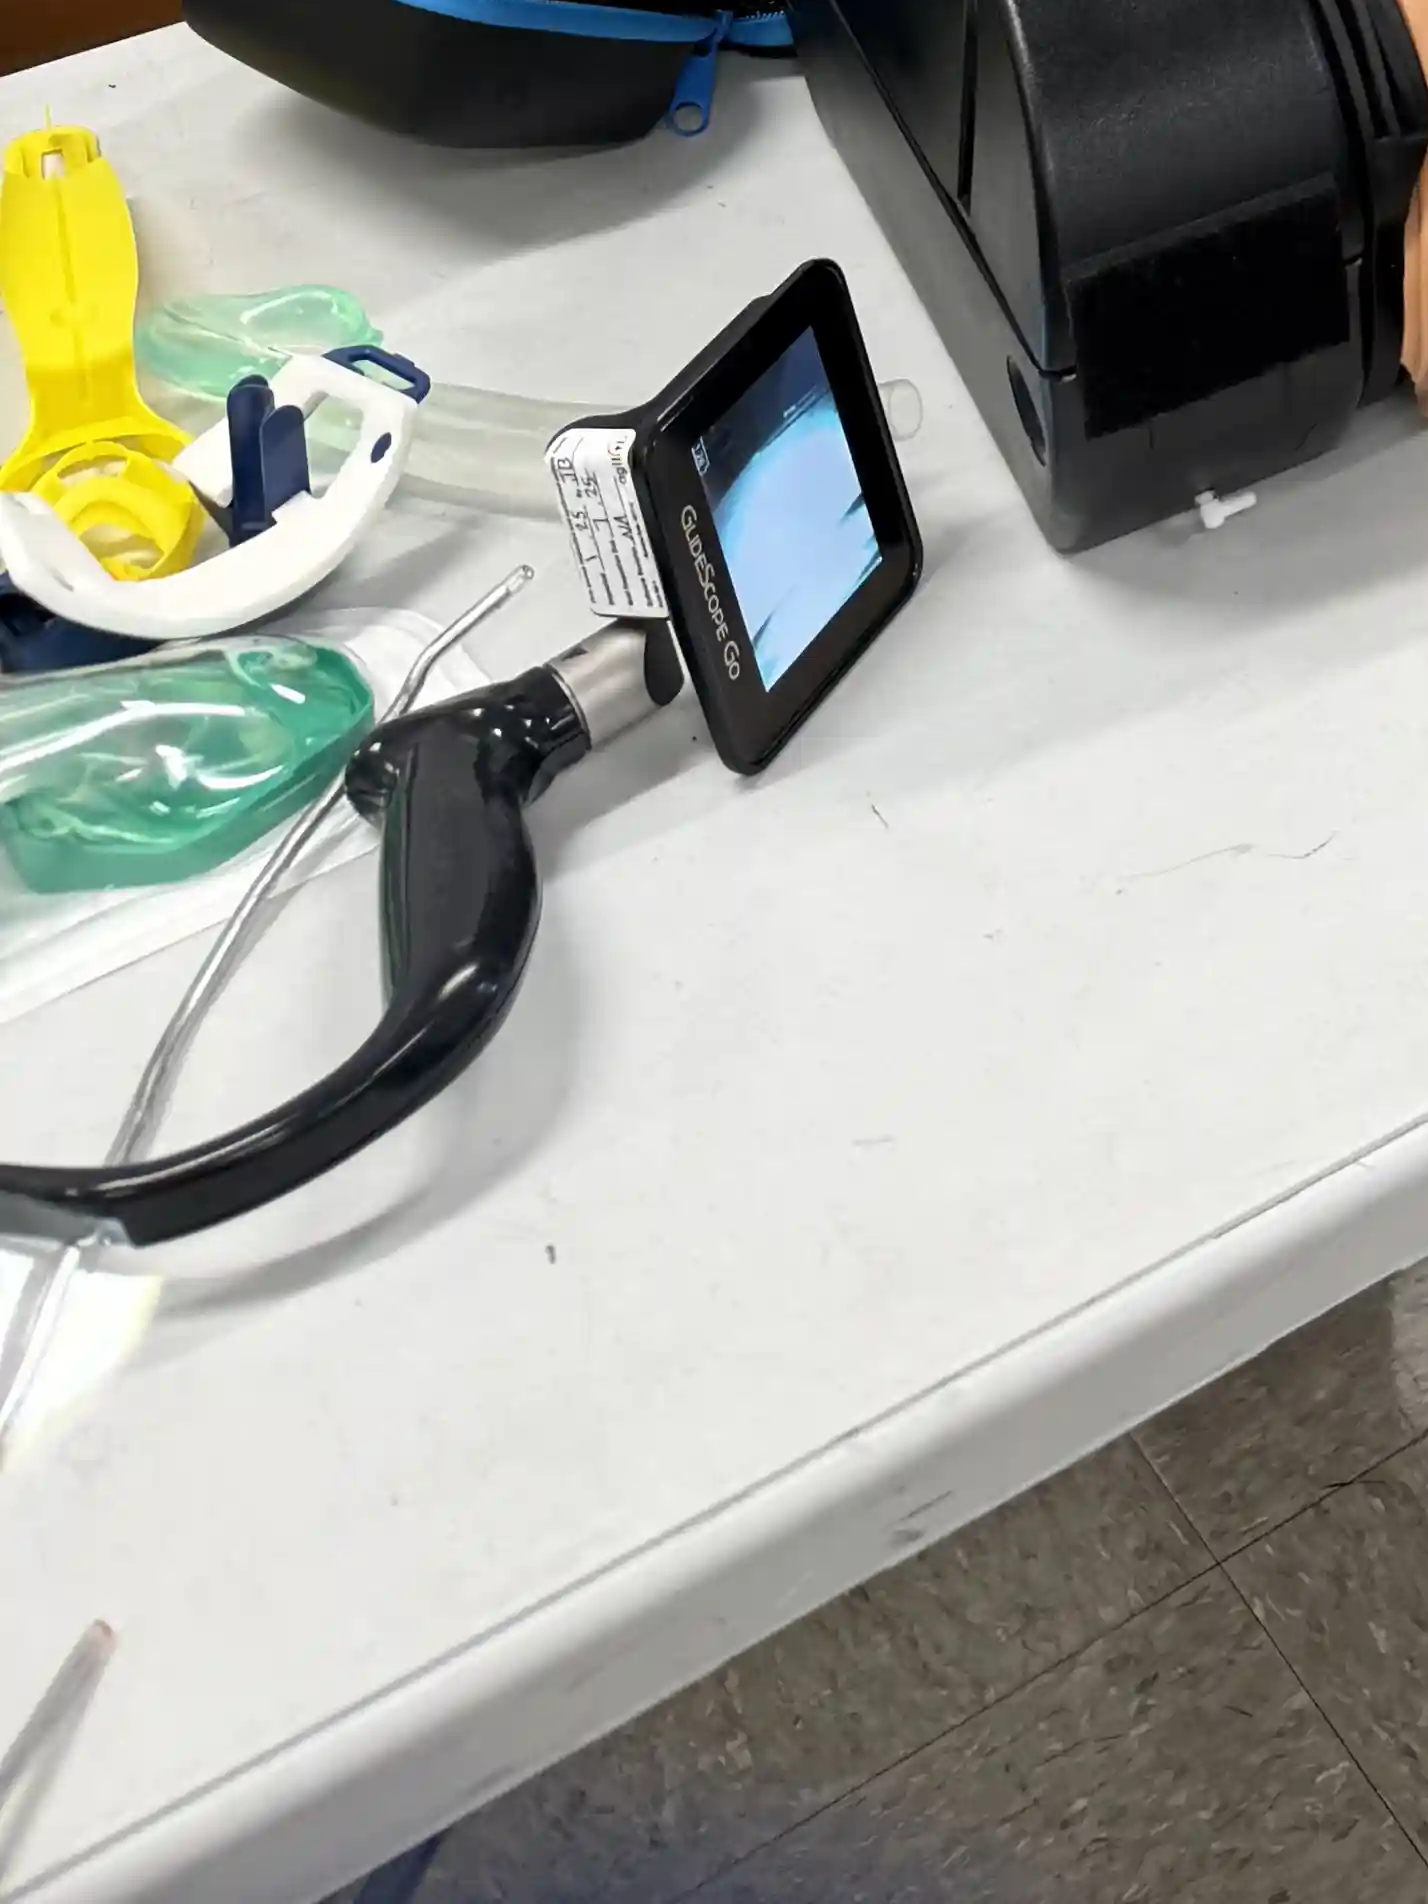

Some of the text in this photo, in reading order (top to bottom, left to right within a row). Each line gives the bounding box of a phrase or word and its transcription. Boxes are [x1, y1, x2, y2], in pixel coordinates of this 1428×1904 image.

[569, 510, 588, 533] 25
[680, 504, 729, 643] GLIDESCOPE
[723, 640, 741, 681] GO
